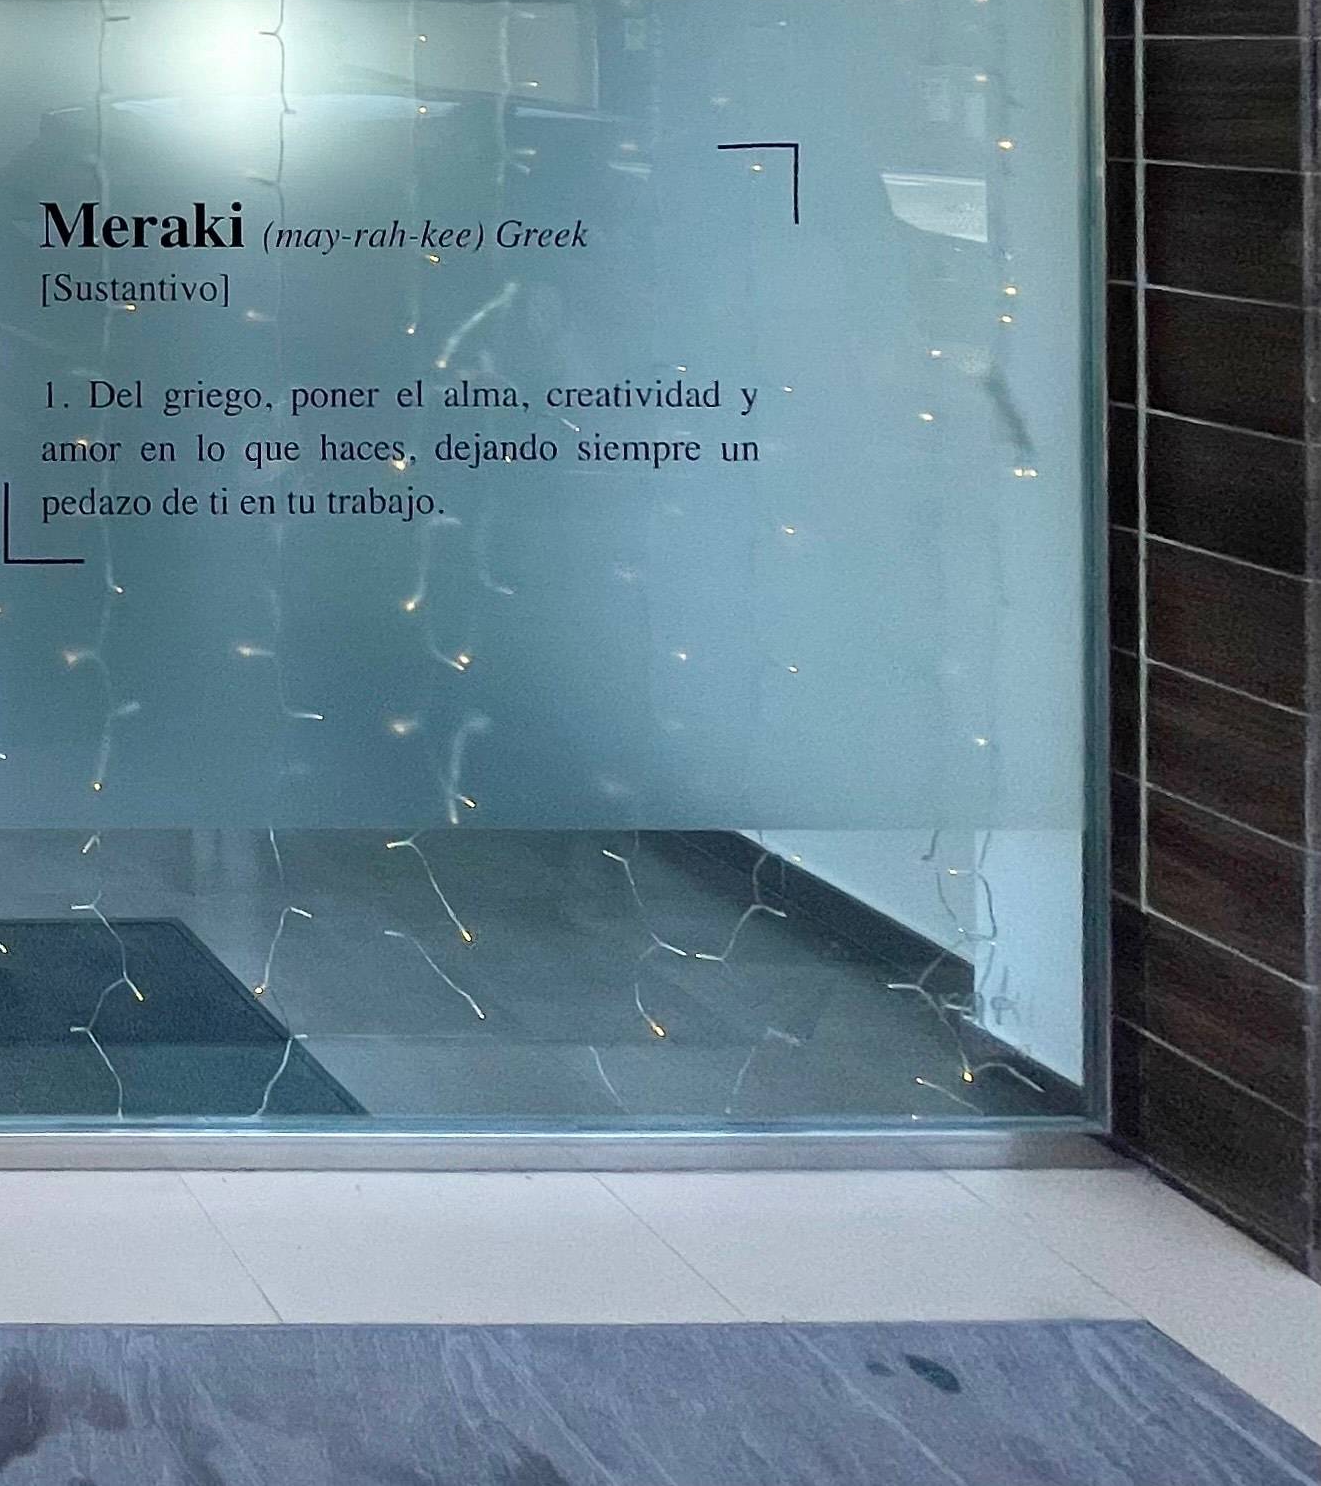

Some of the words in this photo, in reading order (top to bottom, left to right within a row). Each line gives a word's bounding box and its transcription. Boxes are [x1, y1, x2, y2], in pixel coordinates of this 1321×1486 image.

[39, 201, 245, 248] Meraki
[263, 219, 484, 256] (may-rah-kee)
[496, 219, 587, 248] Greek
[42, 273, 229, 308] [Sustantivo]
[46, 381, 69, 409] 1.
[90, 380, 142, 409] Del
[163, 380, 273, 417] griego,
[292, 388, 380, 417] poner
[397, 379, 423, 408] el
[444, 380, 529, 409] alma,
[546, 379, 720, 408] creatividad
[740, 388, 758, 416] y
[41, 442, 122, 463] amor
[140, 442, 175, 462] en
[197, 433, 225, 462] lo
[245, 441, 300, 470] que
[320, 433, 416, 463] haces,
[434, 433, 558, 469] dejando
[577, 432, 701, 469] siempre
[721, 441, 759, 462] un
[42, 487, 151, 524] pedazo
[162, 487, 198, 516] de
[209, 487, 228, 515] ti
[240, 495, 275, 515] en
[287, 491, 315, 515] tu
[328, 486, 444, 523] trabajo.
